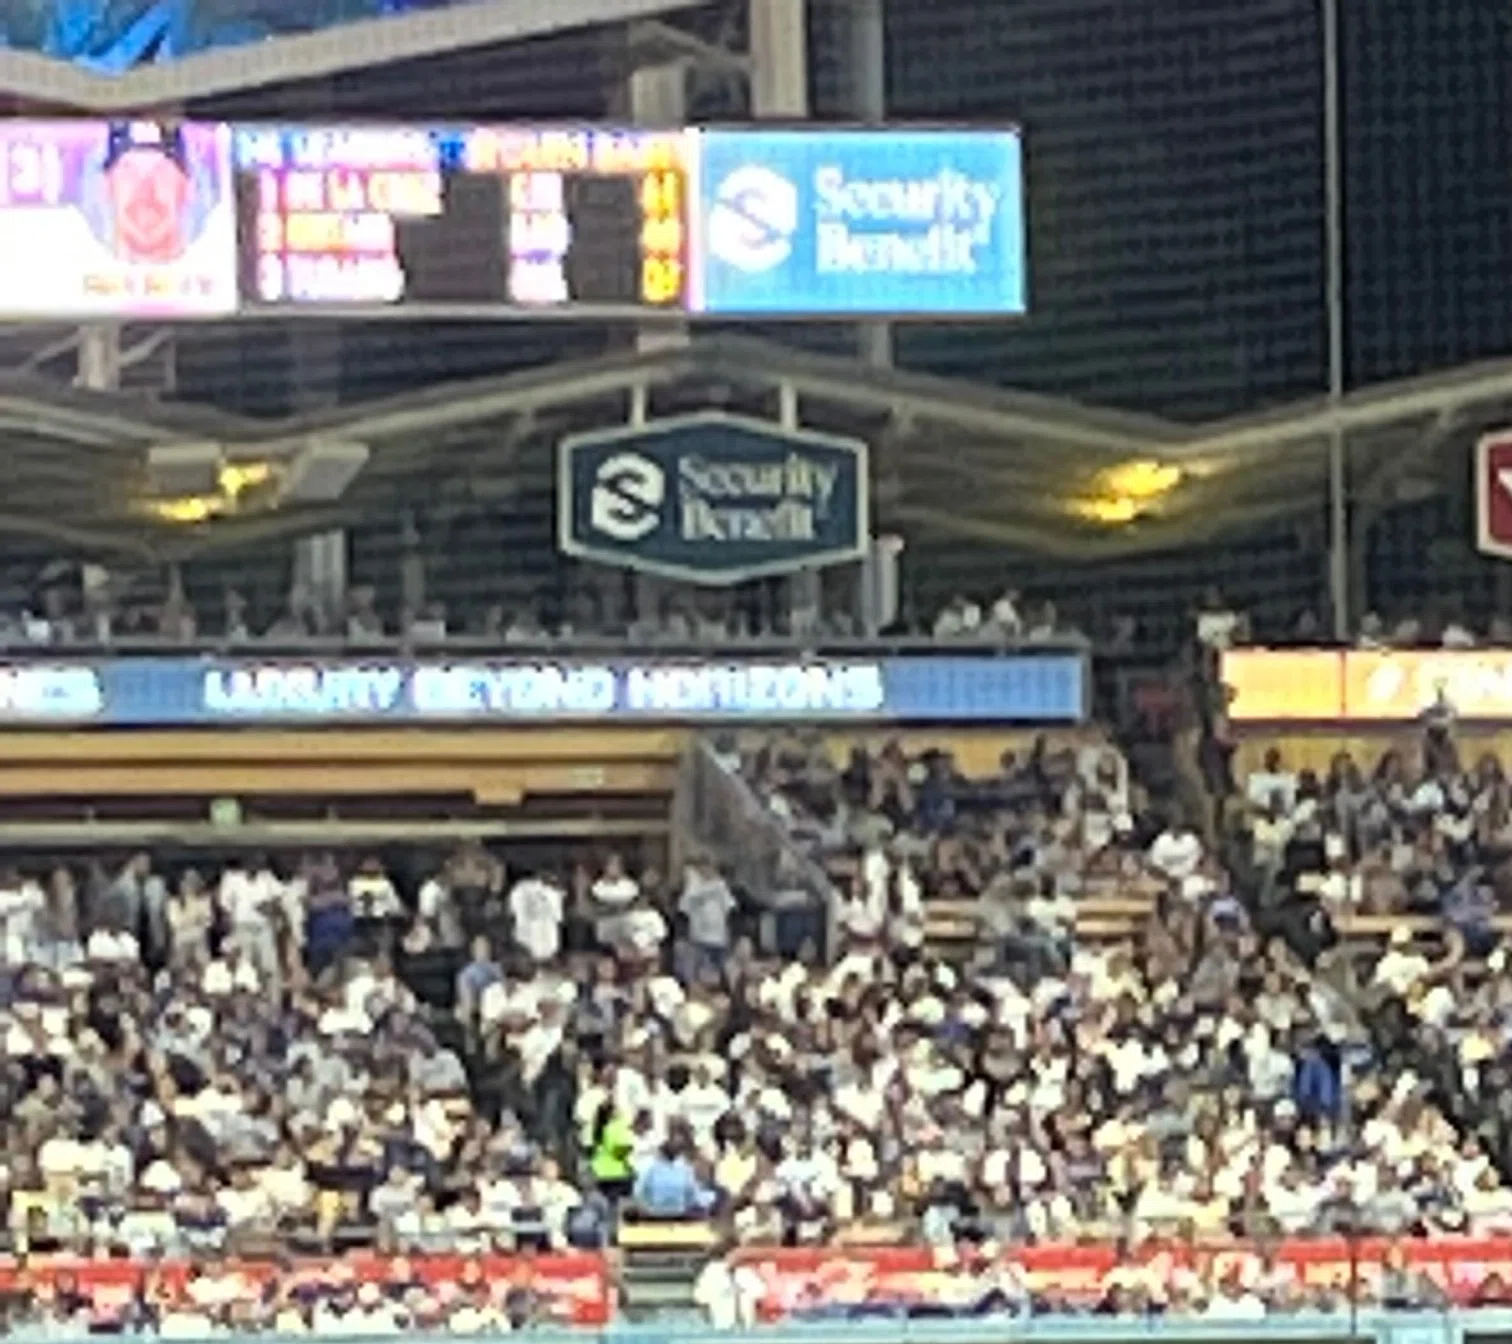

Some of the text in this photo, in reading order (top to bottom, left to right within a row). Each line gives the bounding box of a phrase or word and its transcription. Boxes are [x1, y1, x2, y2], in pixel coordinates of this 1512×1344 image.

[814, 163, 1000, 245] Security
[815, 221, 977, 274] Benefit
[677, 452, 838, 519] Security
[203, 666, 400, 711] LUXURY
